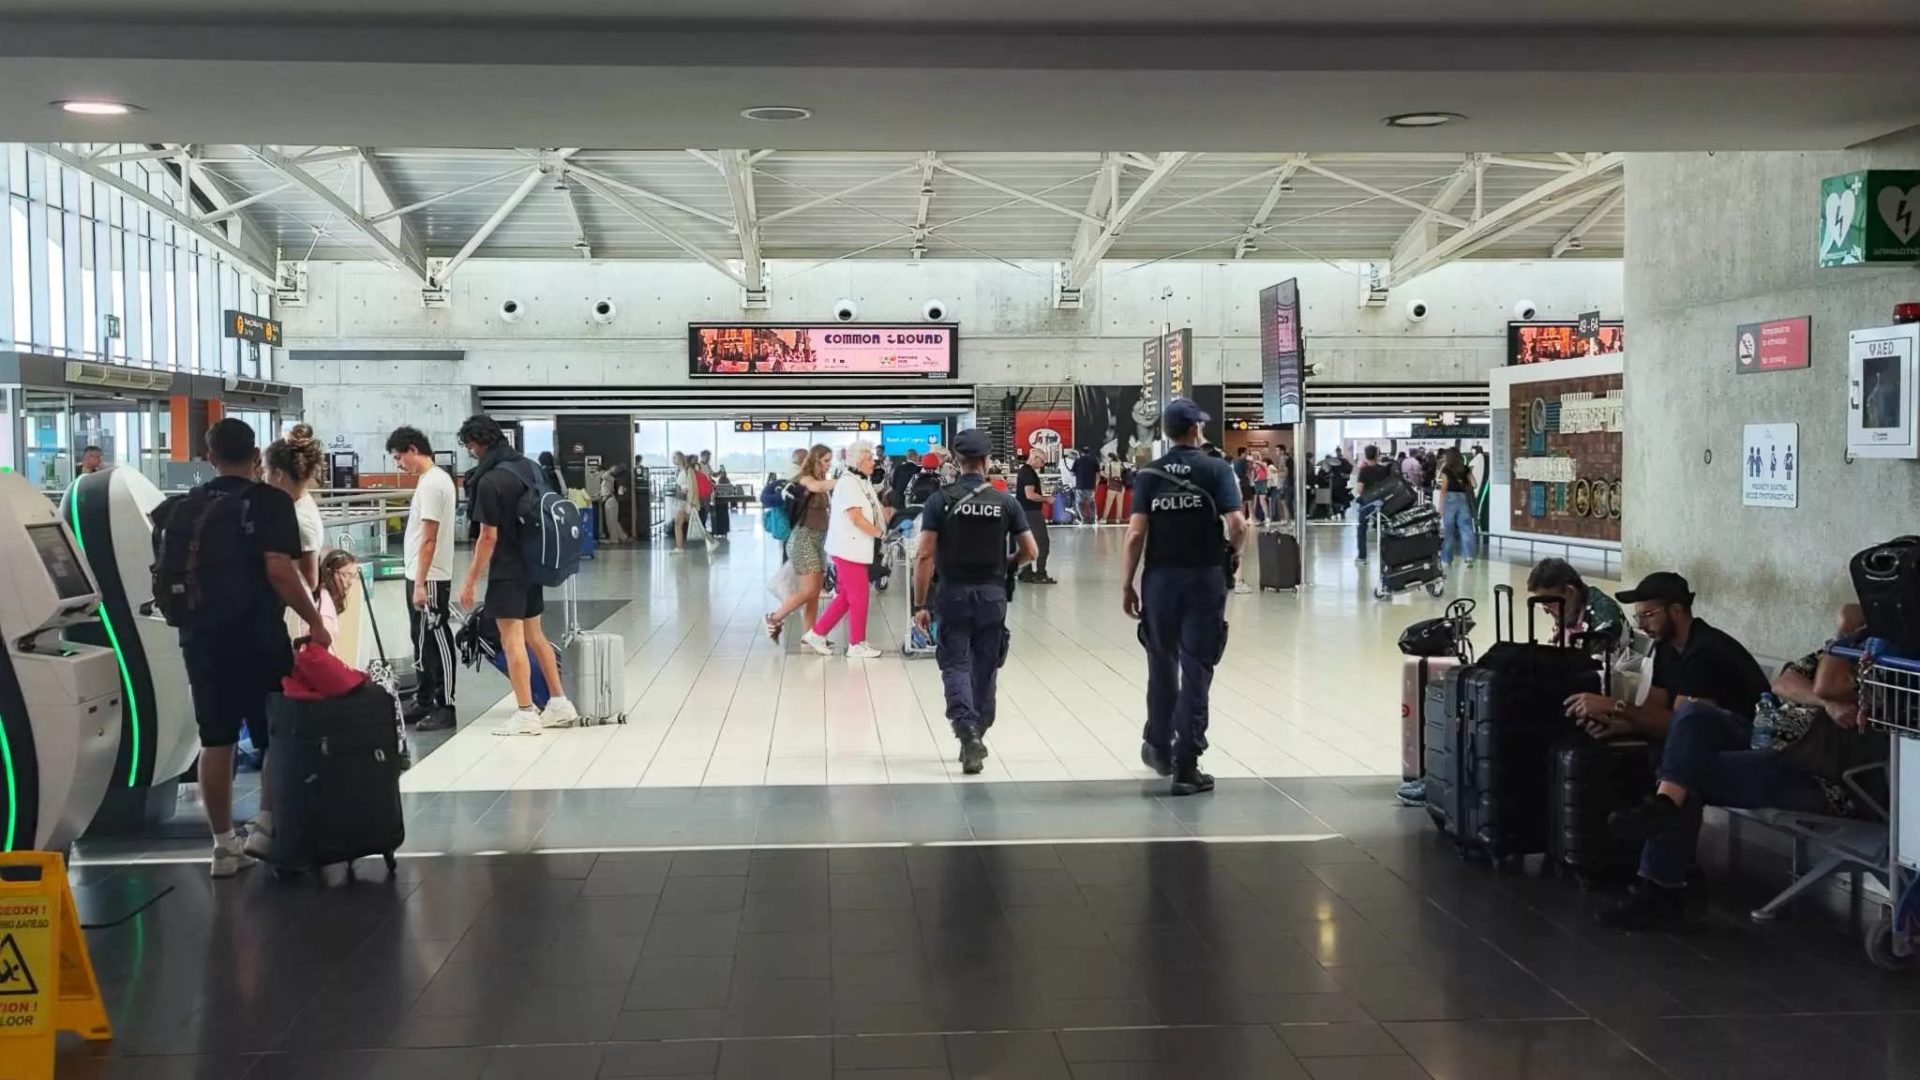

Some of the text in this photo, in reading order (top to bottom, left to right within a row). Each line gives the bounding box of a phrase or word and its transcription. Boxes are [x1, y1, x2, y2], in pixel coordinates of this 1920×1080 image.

[824, 334, 880, 345] COMMON
[1877, 342, 1894, 355] AED
[1151, 495, 1203, 512] POLICE
